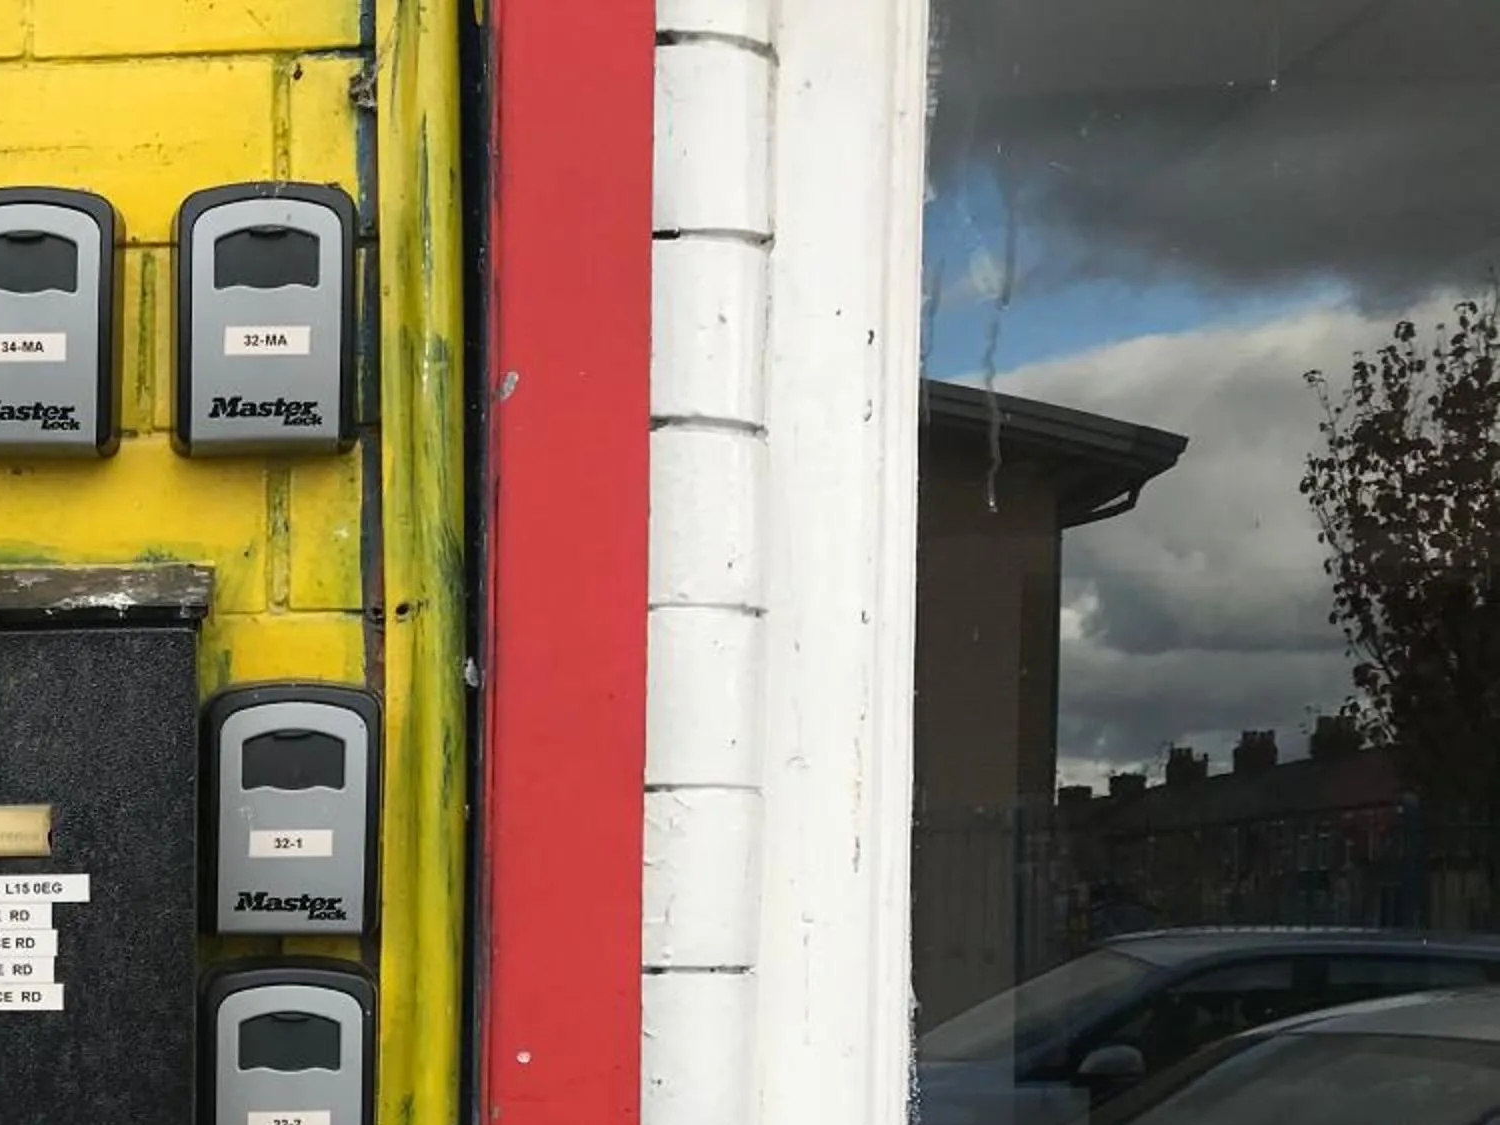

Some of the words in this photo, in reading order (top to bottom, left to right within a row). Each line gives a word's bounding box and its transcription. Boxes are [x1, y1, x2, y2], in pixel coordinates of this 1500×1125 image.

[1, 340, 45, 353] 34-MA
[243, 334, 288, 347] 32-MA
[208, 396, 319, 419] Master
[41, 418, 80, 431] Lock
[283, 413, 322, 427] Lock
[274, 838, 303, 849] 32-1
[5, 883, 30, 895] L15
[234, 892, 343, 912] Master
[9, 910, 30, 922] RD
[308, 908, 347, 920] Lock
[15, 937, 36, 949] RD
[12, 964, 33, 976] RD
[21, 991, 42, 1003] RD
